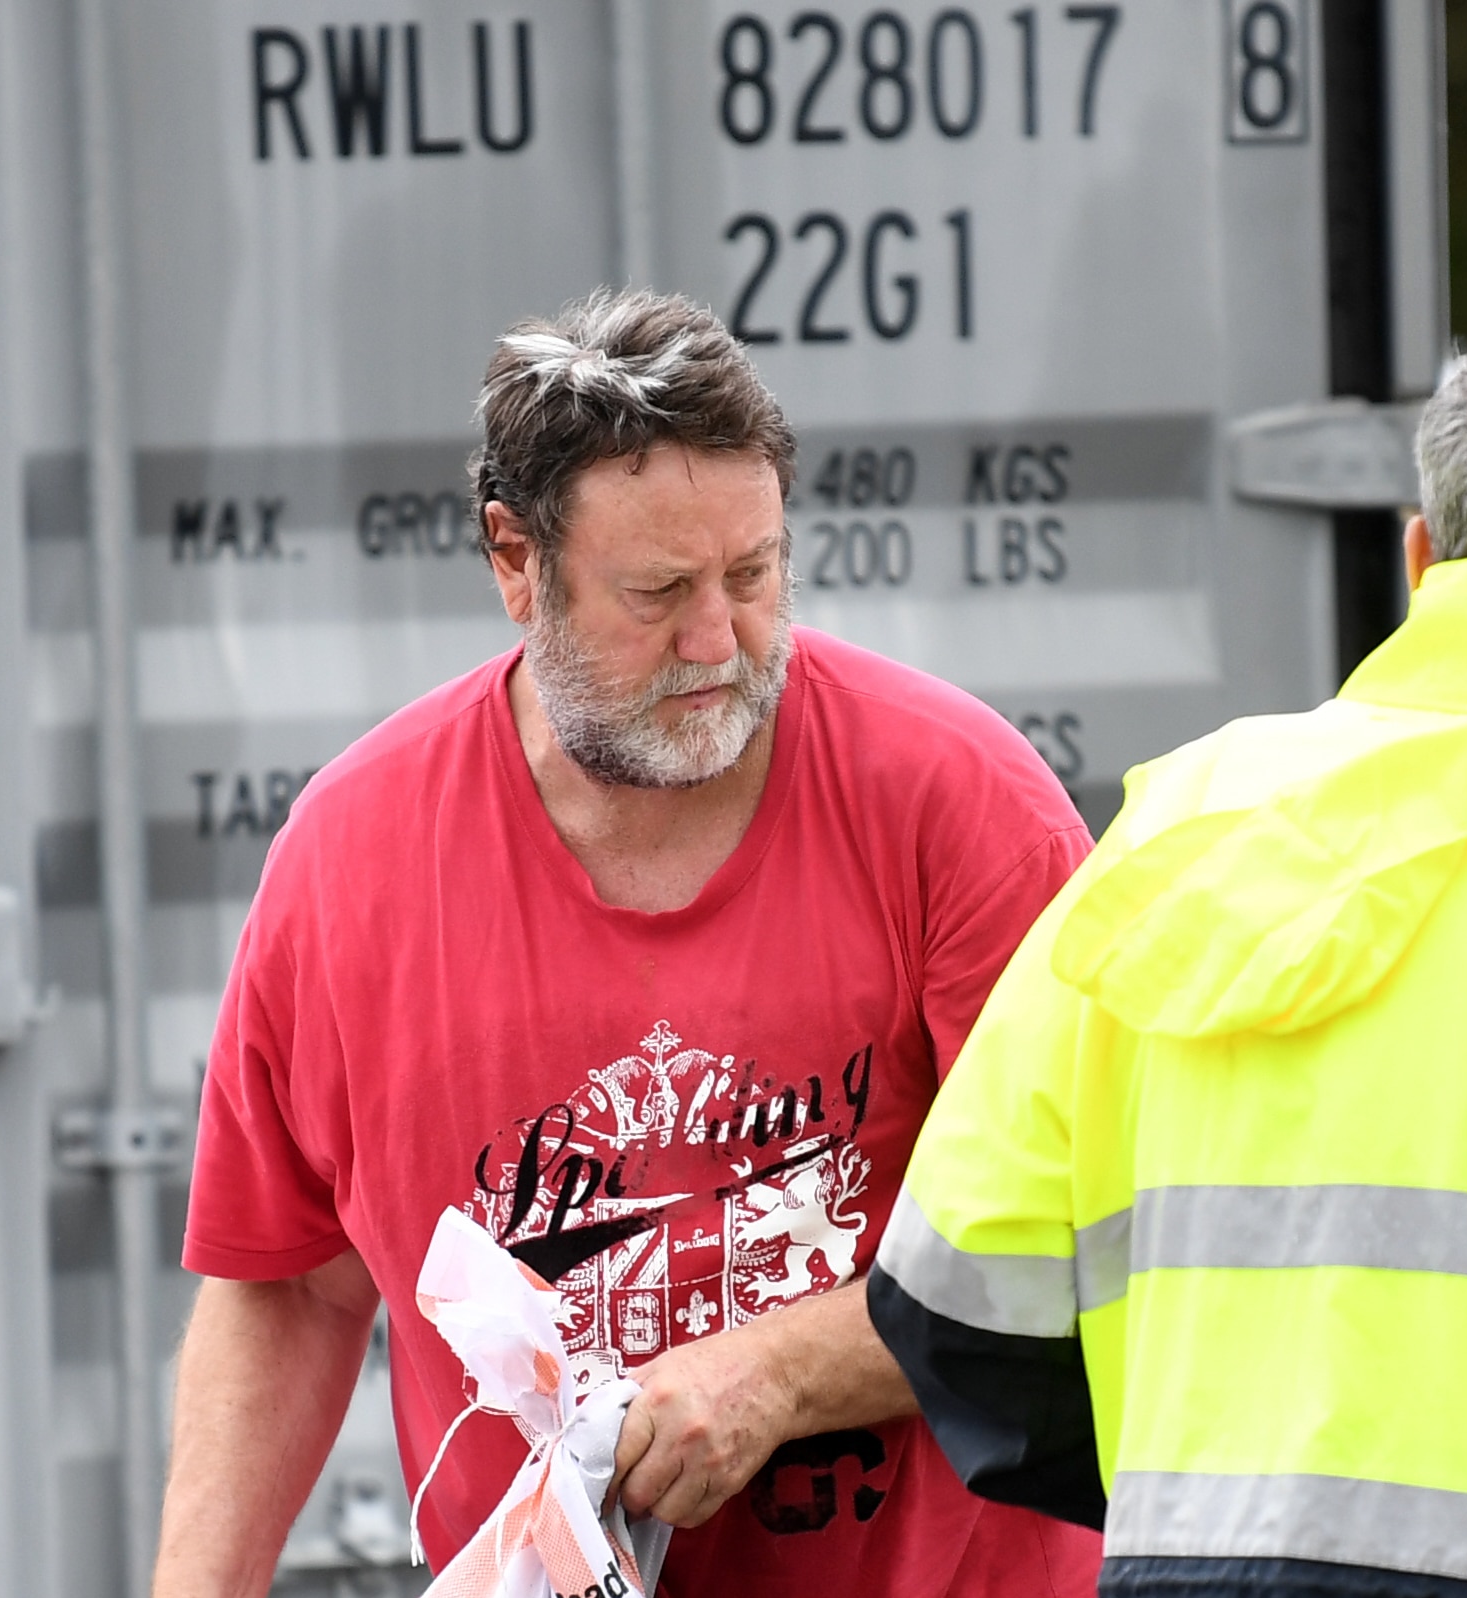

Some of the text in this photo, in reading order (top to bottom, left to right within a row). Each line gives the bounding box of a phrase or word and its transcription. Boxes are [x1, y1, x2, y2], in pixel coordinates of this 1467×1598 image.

[251, 1, 1294, 161] RWLU 828017 8
[724, 209, 976, 344] 22G1
[964, 443, 1073, 508] KGS
[962, 516, 1068, 587] LBS
